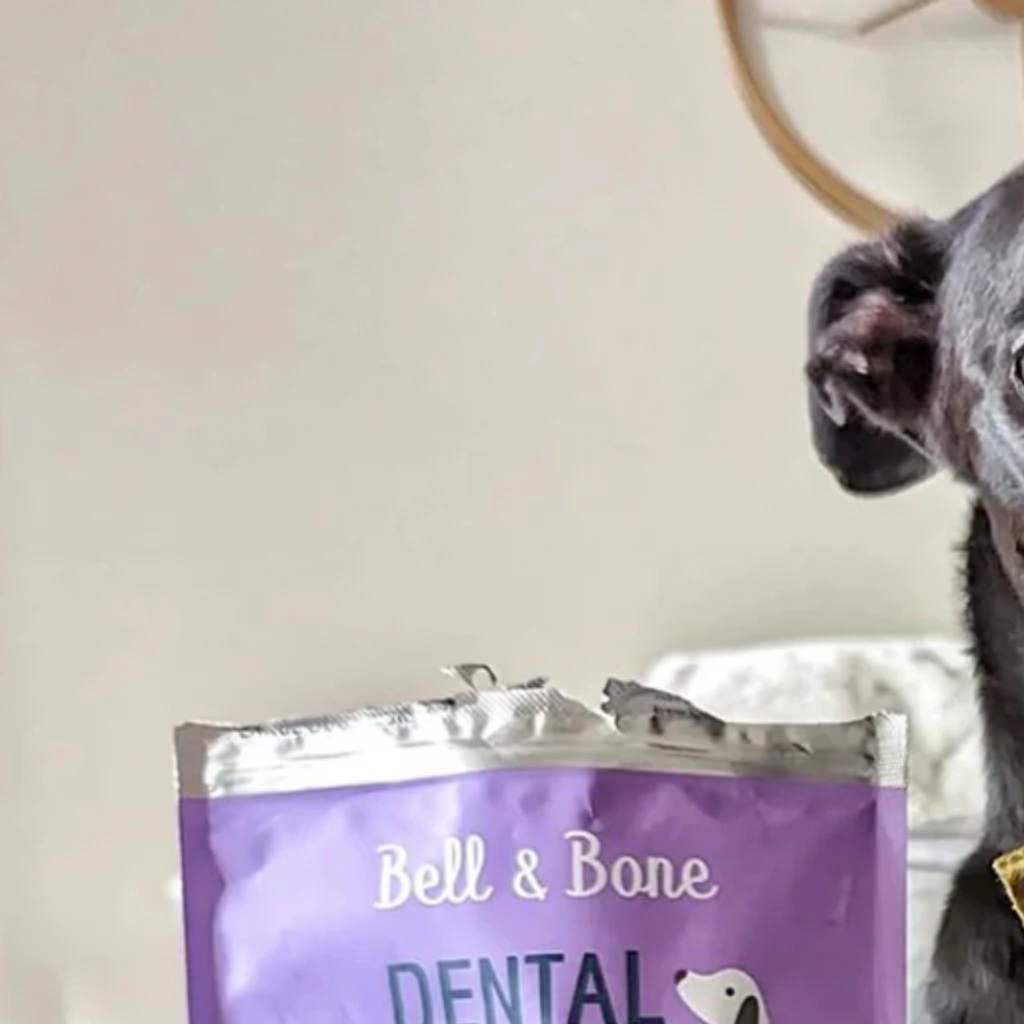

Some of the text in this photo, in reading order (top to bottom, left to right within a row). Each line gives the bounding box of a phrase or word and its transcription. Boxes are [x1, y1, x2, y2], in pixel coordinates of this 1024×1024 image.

[373, 830, 720, 909] Bell & Bone
